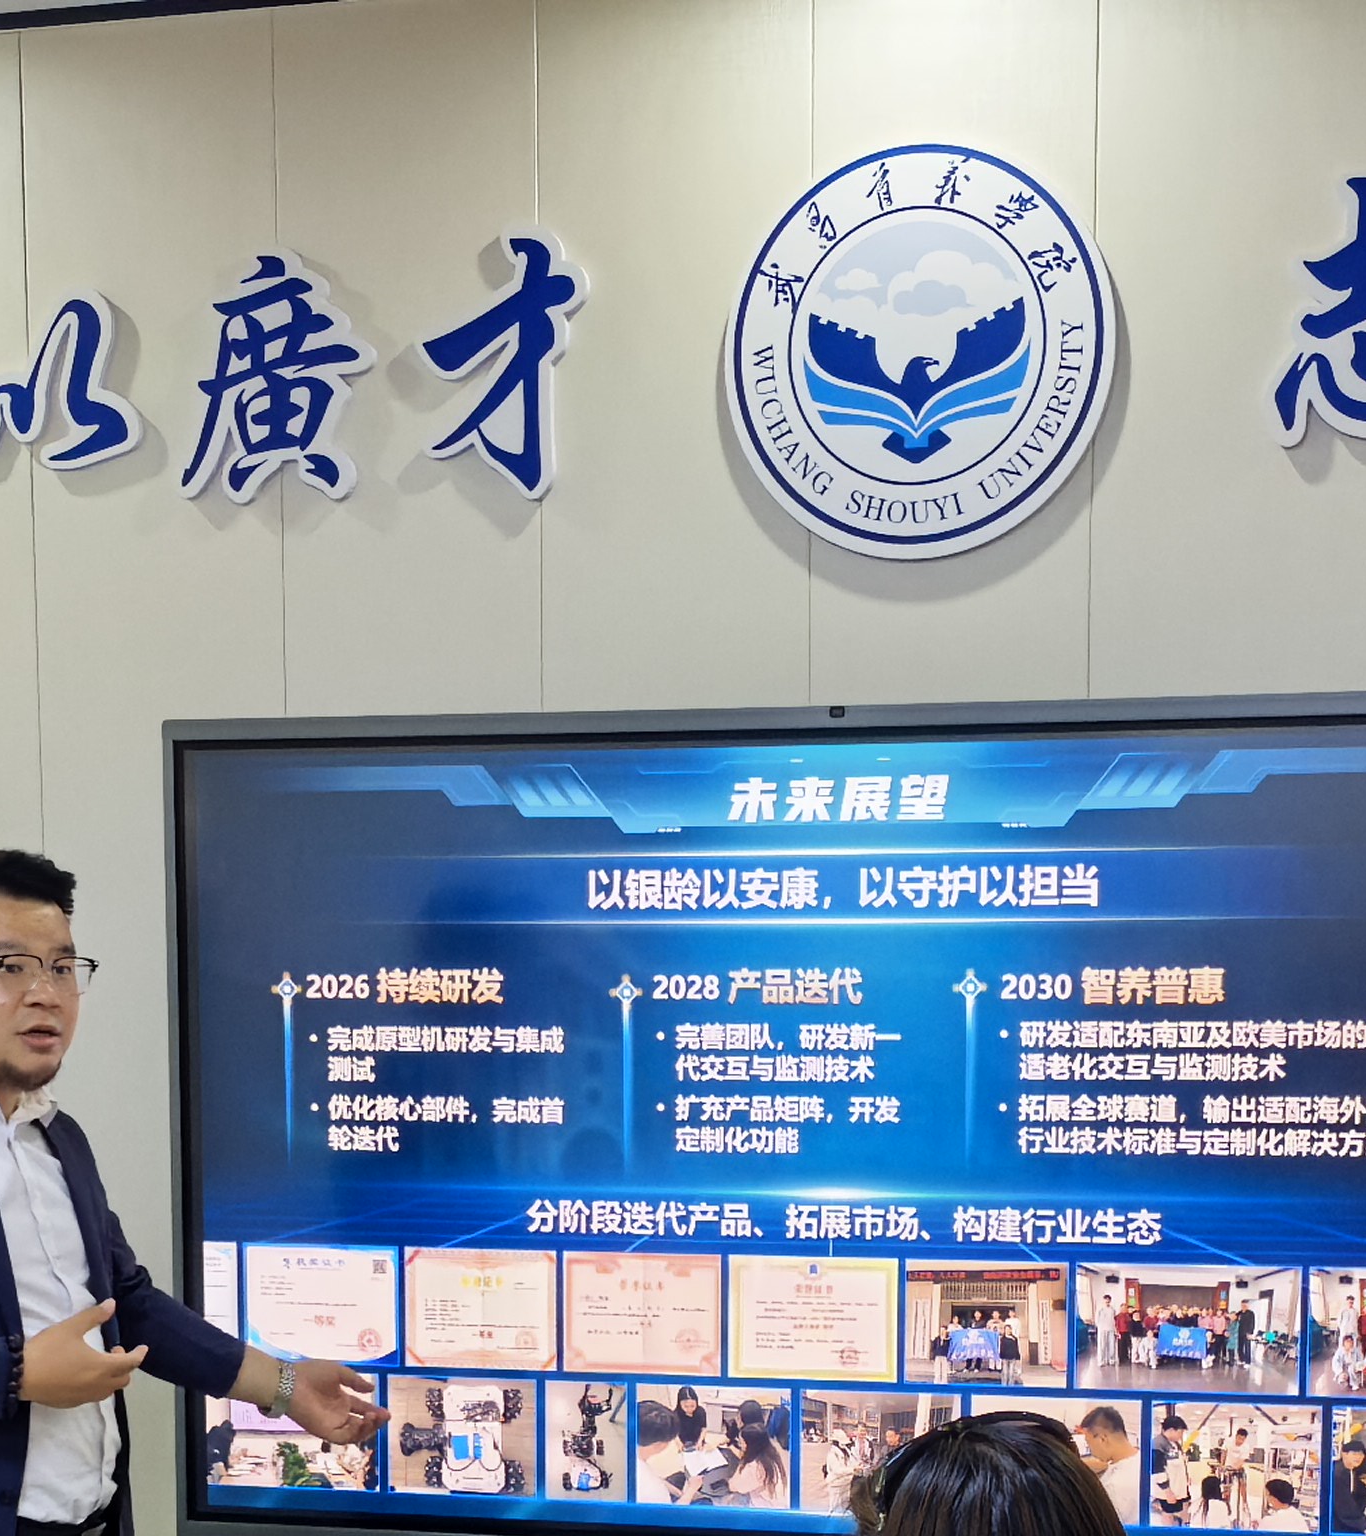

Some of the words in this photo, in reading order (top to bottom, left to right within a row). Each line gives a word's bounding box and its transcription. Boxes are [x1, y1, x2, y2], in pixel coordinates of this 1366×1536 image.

[752, 344, 835, 496] WUCHANG
[845, 489, 965, 524] SHOUYI
[977, 320, 1085, 501] UNIVERSITY
[728, 775, 950, 823] 未来展望
[587, 864, 1099, 910] 以银龄以安康，以守护以担当
[305, 974, 370, 999] 2026
[376, 968, 504, 1004] 持续研发
[652, 974, 720, 1000] 2028
[728, 968, 863, 1004] 产品迭代
[1000, 974, 1072, 1000] 2030
[1080, 967, 1226, 1005] 智养普惠
[327, 1026, 565, 1053] 完成原型机研发与集成
[675, 1023, 902, 1050] 完善团队，研发新一
[327, 1056, 376, 1082] 测试
[675, 1055, 876, 1082] 代交互与监测技术
[1019, 1053, 1287, 1082] 适老化交互与监测技术
[327, 1095, 565, 1125] 优化核心部件，完成首
[675, 1095, 901, 1123] 扩充产品矩阵，开发
[327, 1125, 400, 1152] 轮迭代
[675, 1127, 799, 1153] 定制化功能
[526, 1200, 1163, 1245] 分阶段迭代产品、拓展市场、构建行业生态
